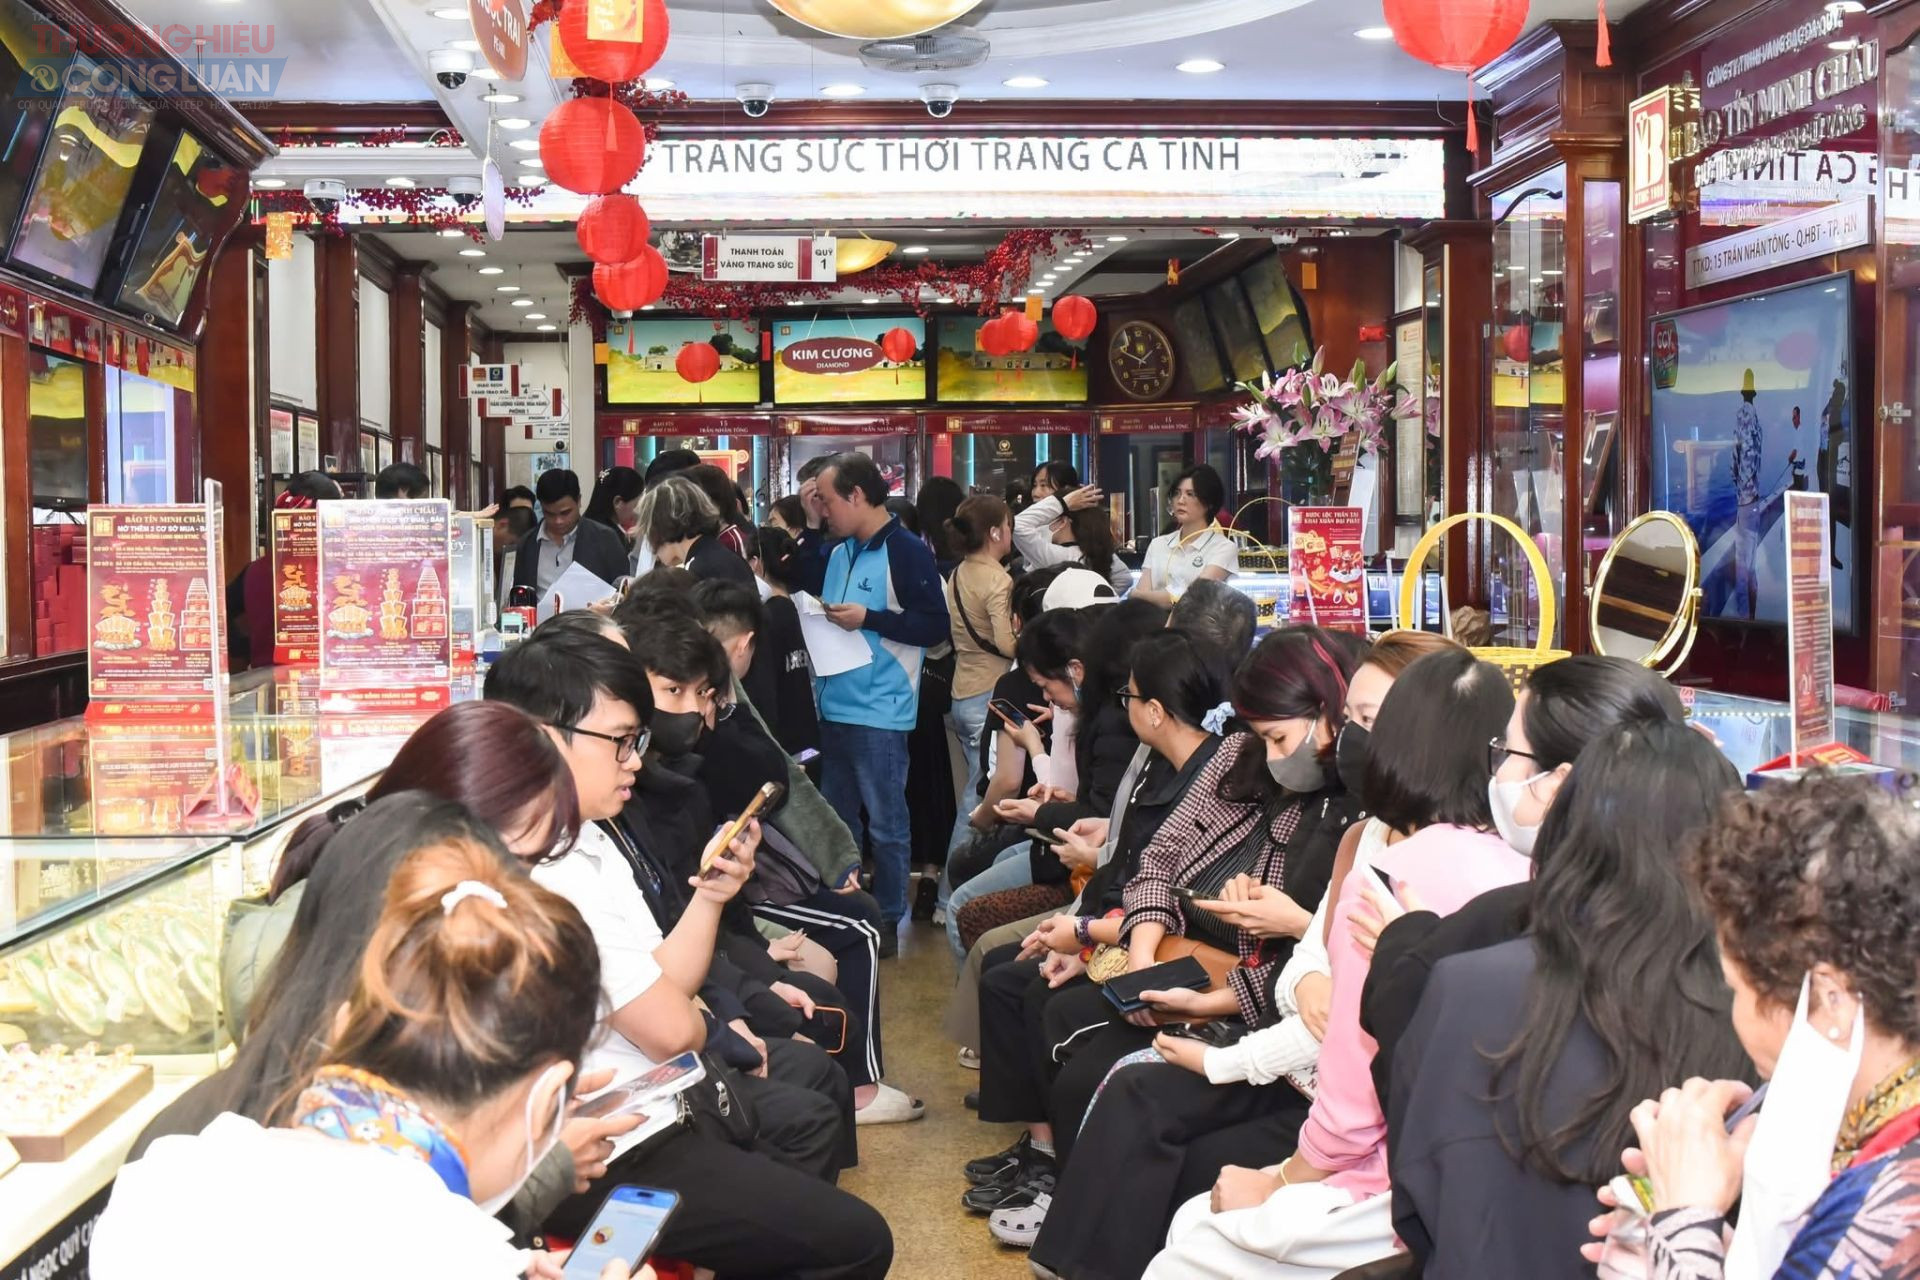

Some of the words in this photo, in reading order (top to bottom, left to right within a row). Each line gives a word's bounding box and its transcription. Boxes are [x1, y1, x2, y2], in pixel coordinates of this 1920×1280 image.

[503, 5, 520, 48] TRAI
[1756, 68, 1813, 126] MINH
[1814, 36, 1880, 101] CHÂU
[661, 143, 783, 173] TRANG
[971, 141, 1090, 172] TRANG
[730, 248, 759, 256] THANH
[761, 246, 784, 256] TOÁN
[720, 259, 745, 268] VÀNG
[747, 261, 775, 269] TRANG
[777, 260, 794, 269] SỨC
[820, 258, 827, 270] 1
[792, 349, 818, 360] KIM
[822, 347, 873, 359] CƯƠNG
[816, 361, 850, 369] DIAMOND
[159, 515, 182, 523] MINH
